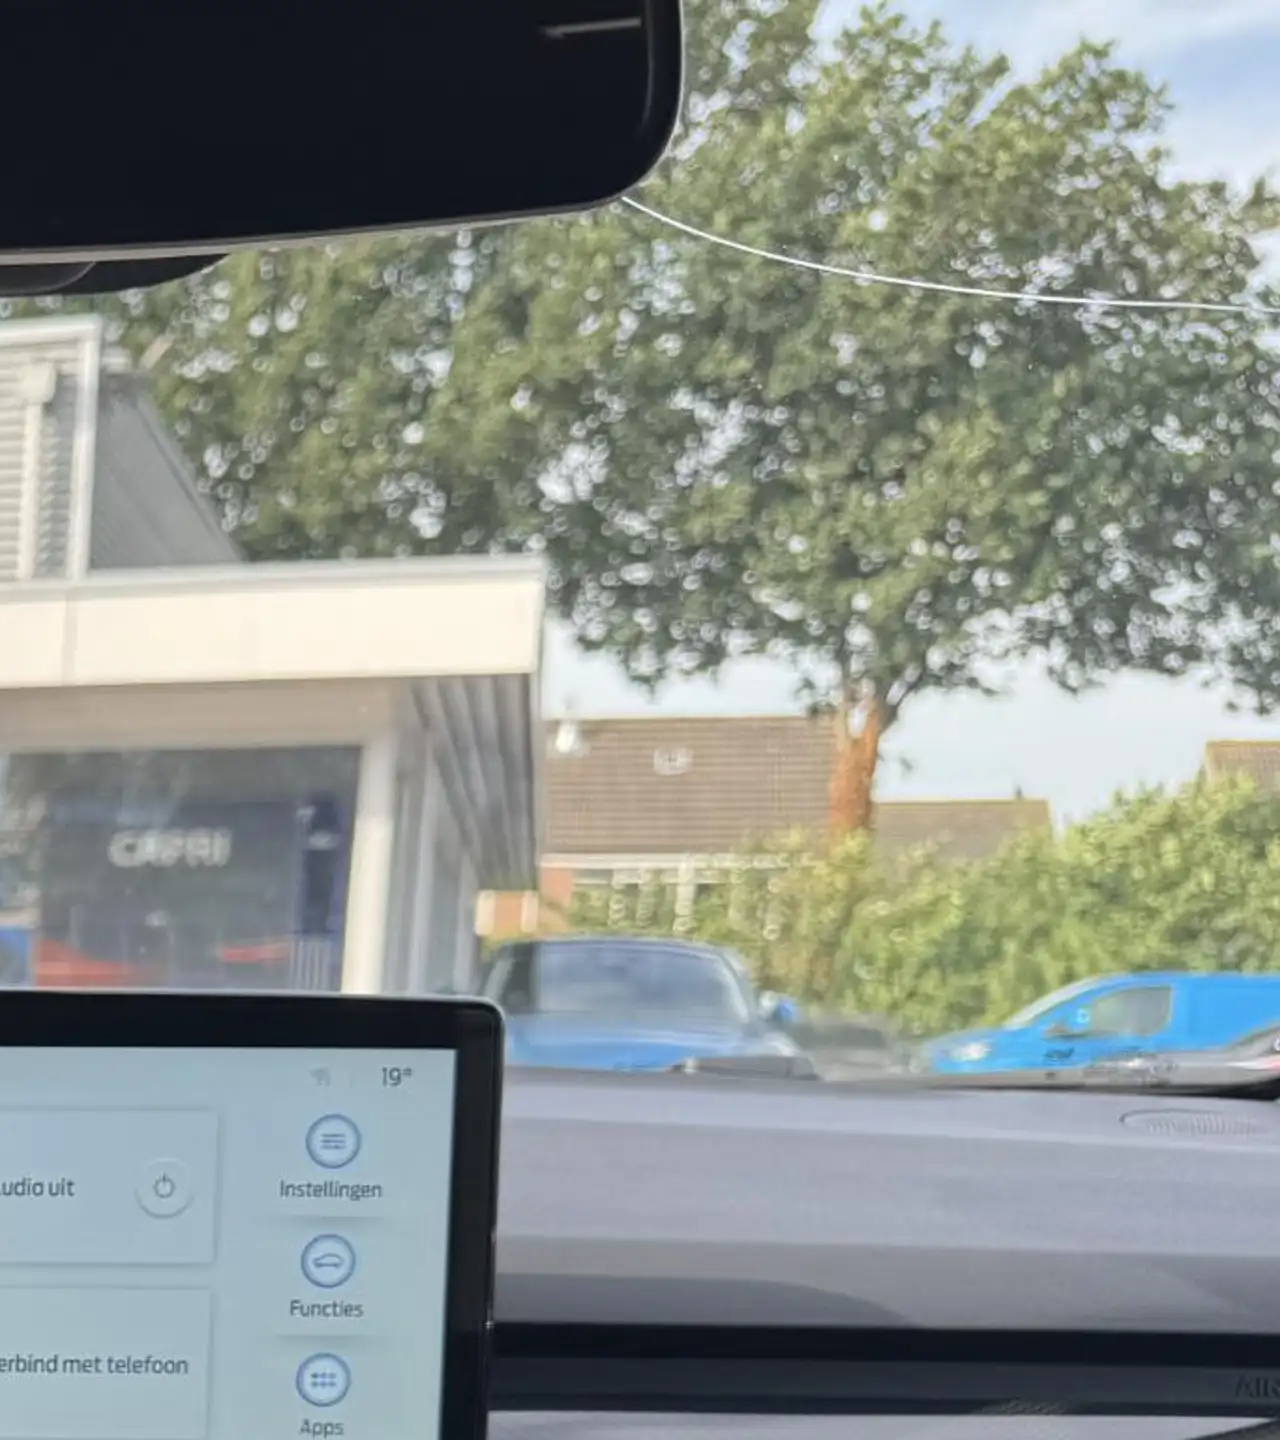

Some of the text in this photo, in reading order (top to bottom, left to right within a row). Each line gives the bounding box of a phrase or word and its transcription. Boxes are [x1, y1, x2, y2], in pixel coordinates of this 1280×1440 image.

[48, 1177, 76, 1197] uit
[279, 1180, 383, 1201] Instellingen
[289, 1299, 365, 1318] Functies
[61, 1355, 102, 1375] met
[106, 1355, 190, 1376] telefoon
[299, 1418, 345, 1440] Apps
